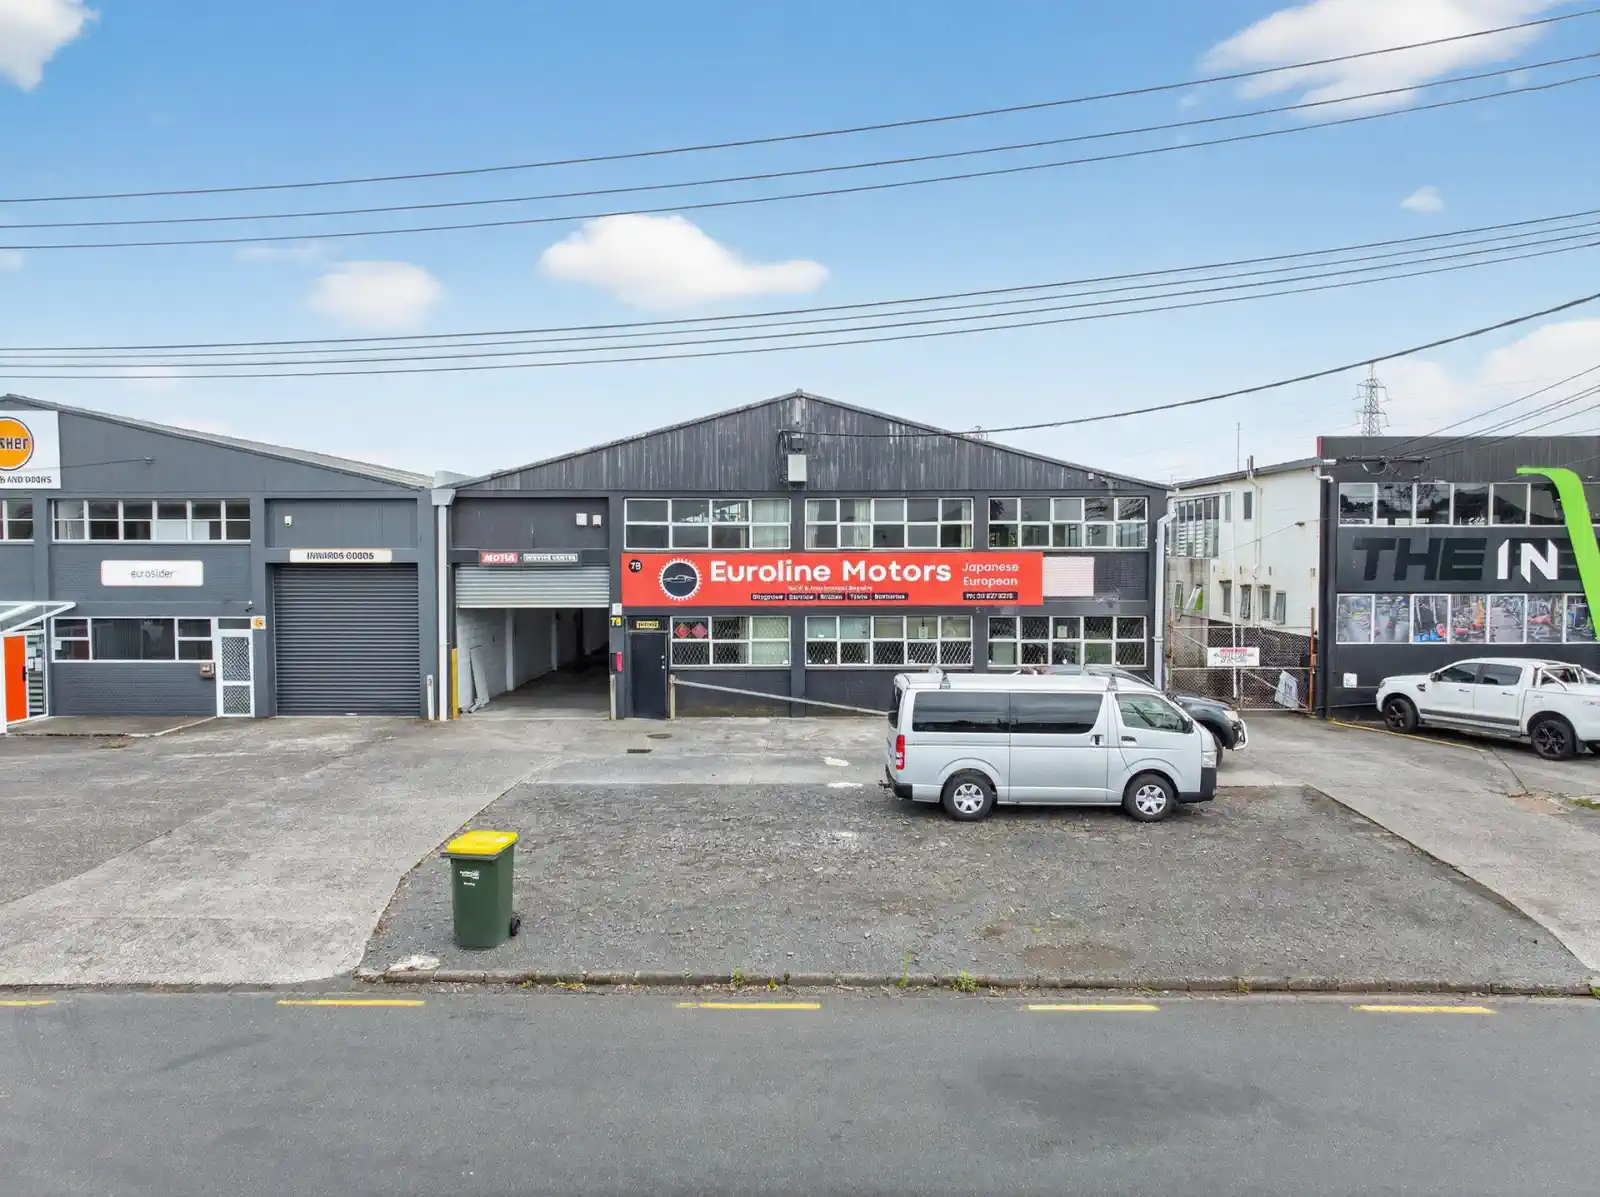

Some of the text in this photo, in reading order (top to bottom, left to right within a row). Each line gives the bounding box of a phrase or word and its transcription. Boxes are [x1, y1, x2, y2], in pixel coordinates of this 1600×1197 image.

[8, 476, 23, 484] AND
[25, 476, 52, 484] DOORS
[306, 551, 374, 560] INWARDS GOODS
[1353, 537, 1487, 581] THE
[710, 559, 951, 582] Euroline Motors
[962, 562, 1019, 574] Japanese
[963, 576, 1018, 588] European
